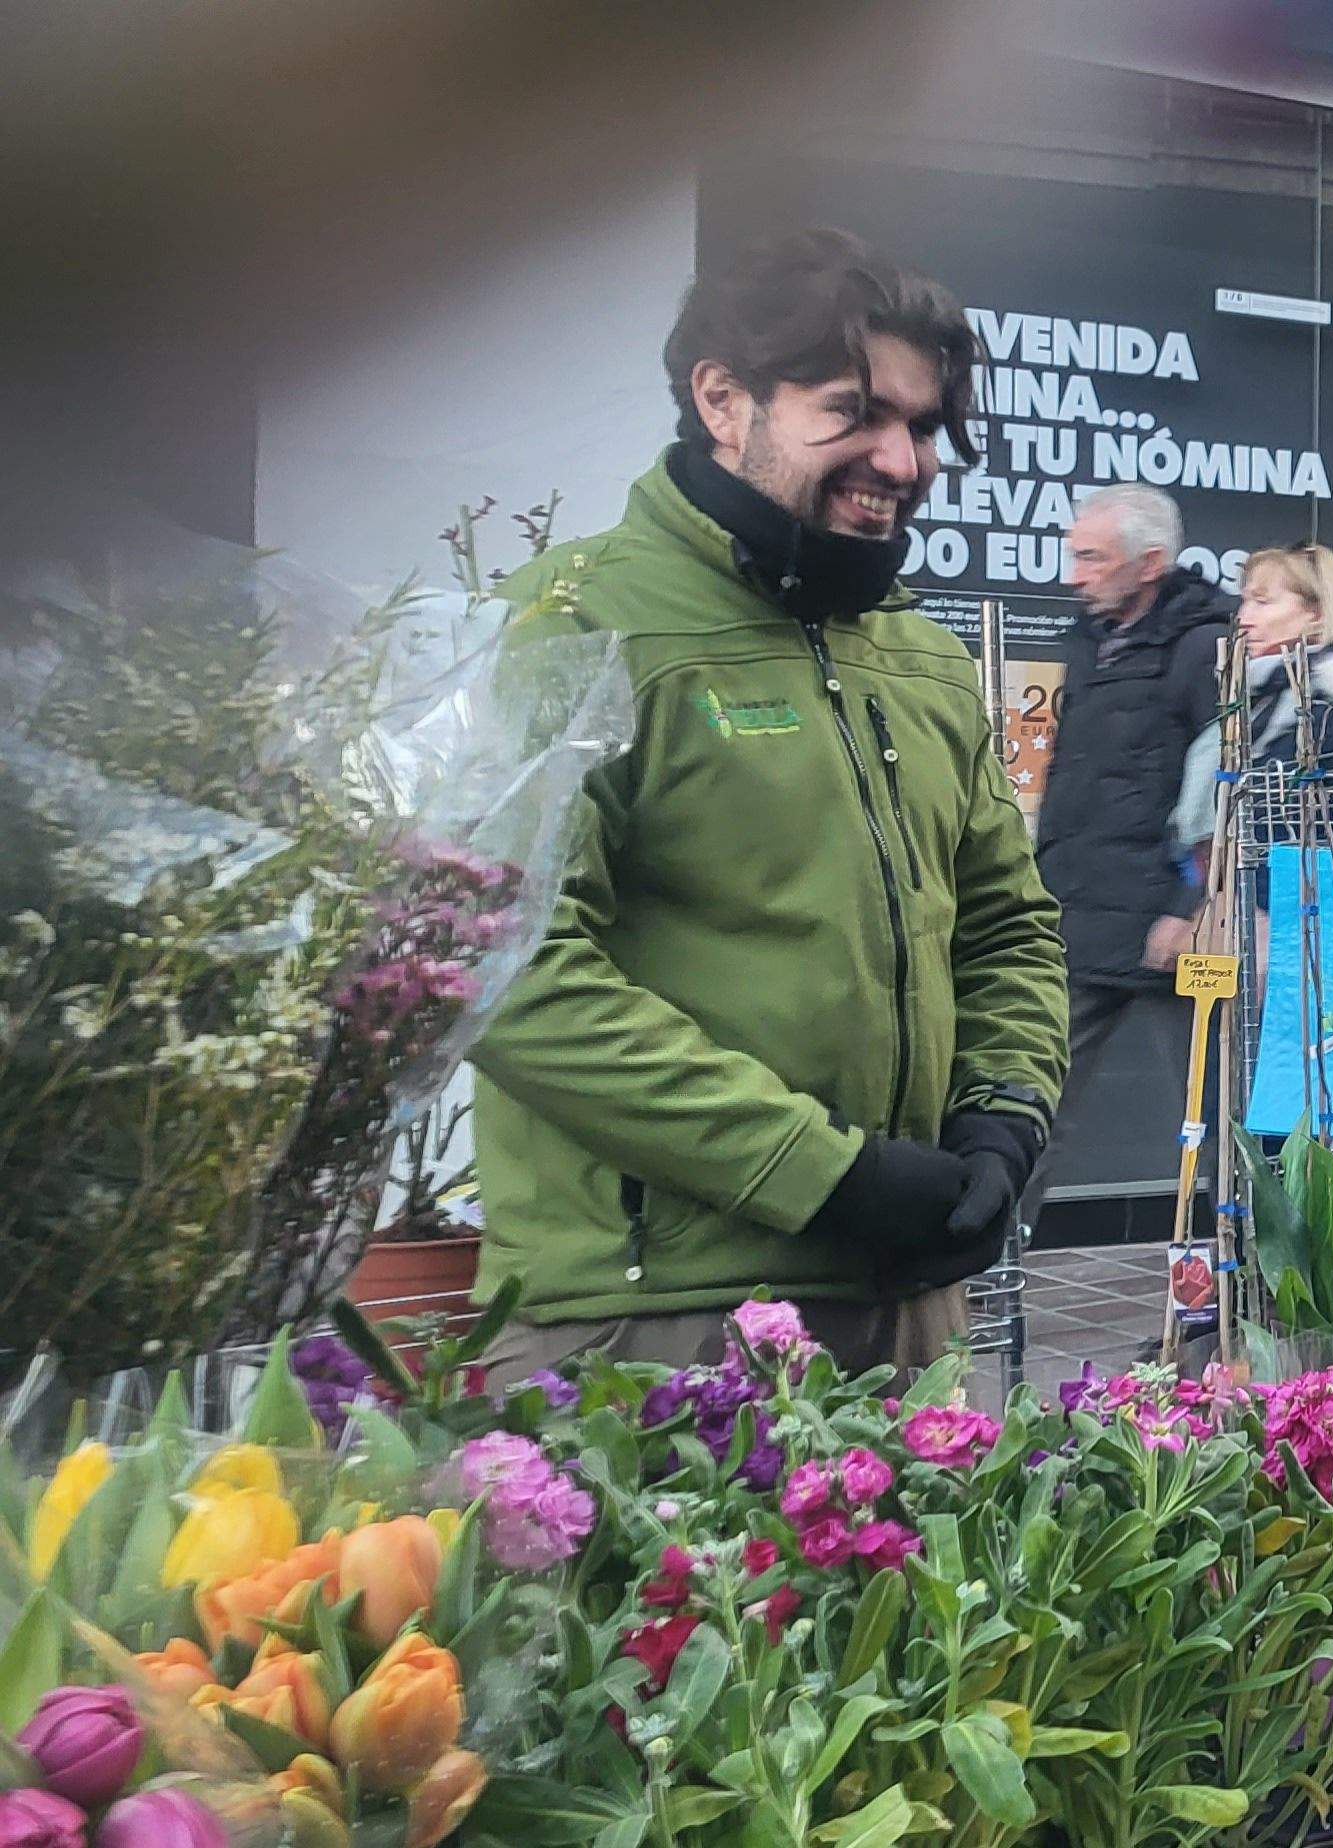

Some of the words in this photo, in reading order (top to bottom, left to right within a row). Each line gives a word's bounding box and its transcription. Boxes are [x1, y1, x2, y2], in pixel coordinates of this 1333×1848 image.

[1003, 422, 1077, 476] TU
[1093, 427, 1332, 499] NÓMINA
[913, 466, 1106, 531] LÉVA
[985, 531, 1249, 596] EUOS
